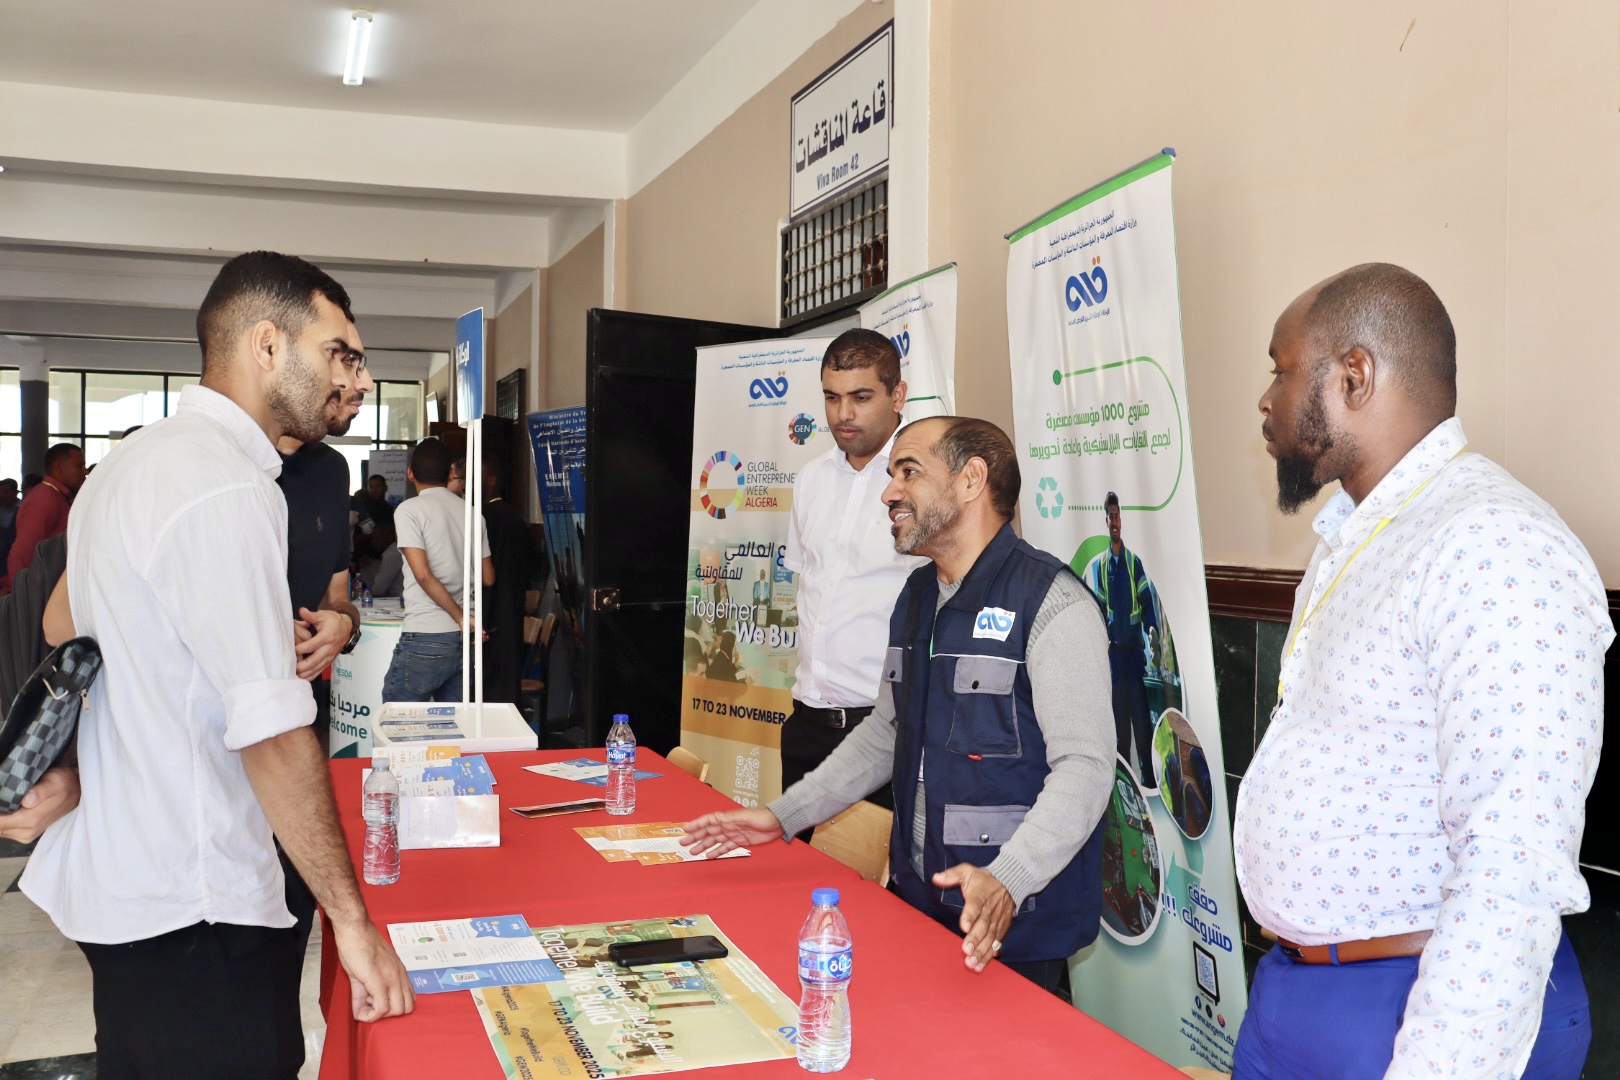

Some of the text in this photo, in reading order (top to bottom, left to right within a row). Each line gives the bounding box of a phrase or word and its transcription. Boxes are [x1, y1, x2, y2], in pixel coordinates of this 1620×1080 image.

[795, 79, 886, 174] قاعة المناقشات
[816, 153, 859, 191] Viva Room 42
[1101, 402, 1124, 422] 1000
[794, 424, 811, 433] GEN
[1029, 437, 1060, 460] تدويرها
[1151, 427, 1171, 455] لجمع
[746, 472, 798, 484] ENTREPRENE
[747, 461, 778, 472] GLOBAL
[745, 496, 778, 508] ALGERIA
[746, 485, 769, 496] WEEK
[724, 541, 775, 565] العالمي
[690, 595, 759, 624] Together
[736, 620, 765, 645] We
[338, 693, 370, 719] مرحبا
[692, 698, 787, 725] 17 TO 23 NOVEMBER
[608, 751, 627, 761] Hayat
[1188, 883, 1218, 916] حقق
[1182, 906, 1232, 953] مشروعك
[565, 971, 624, 1026] We Build
[552, 1007, 568, 1016] TO
[556, 1016, 573, 1025] 23
[560, 1025, 594, 1060] NOVEMBER
[581, 1059, 605, 1079] 2025
